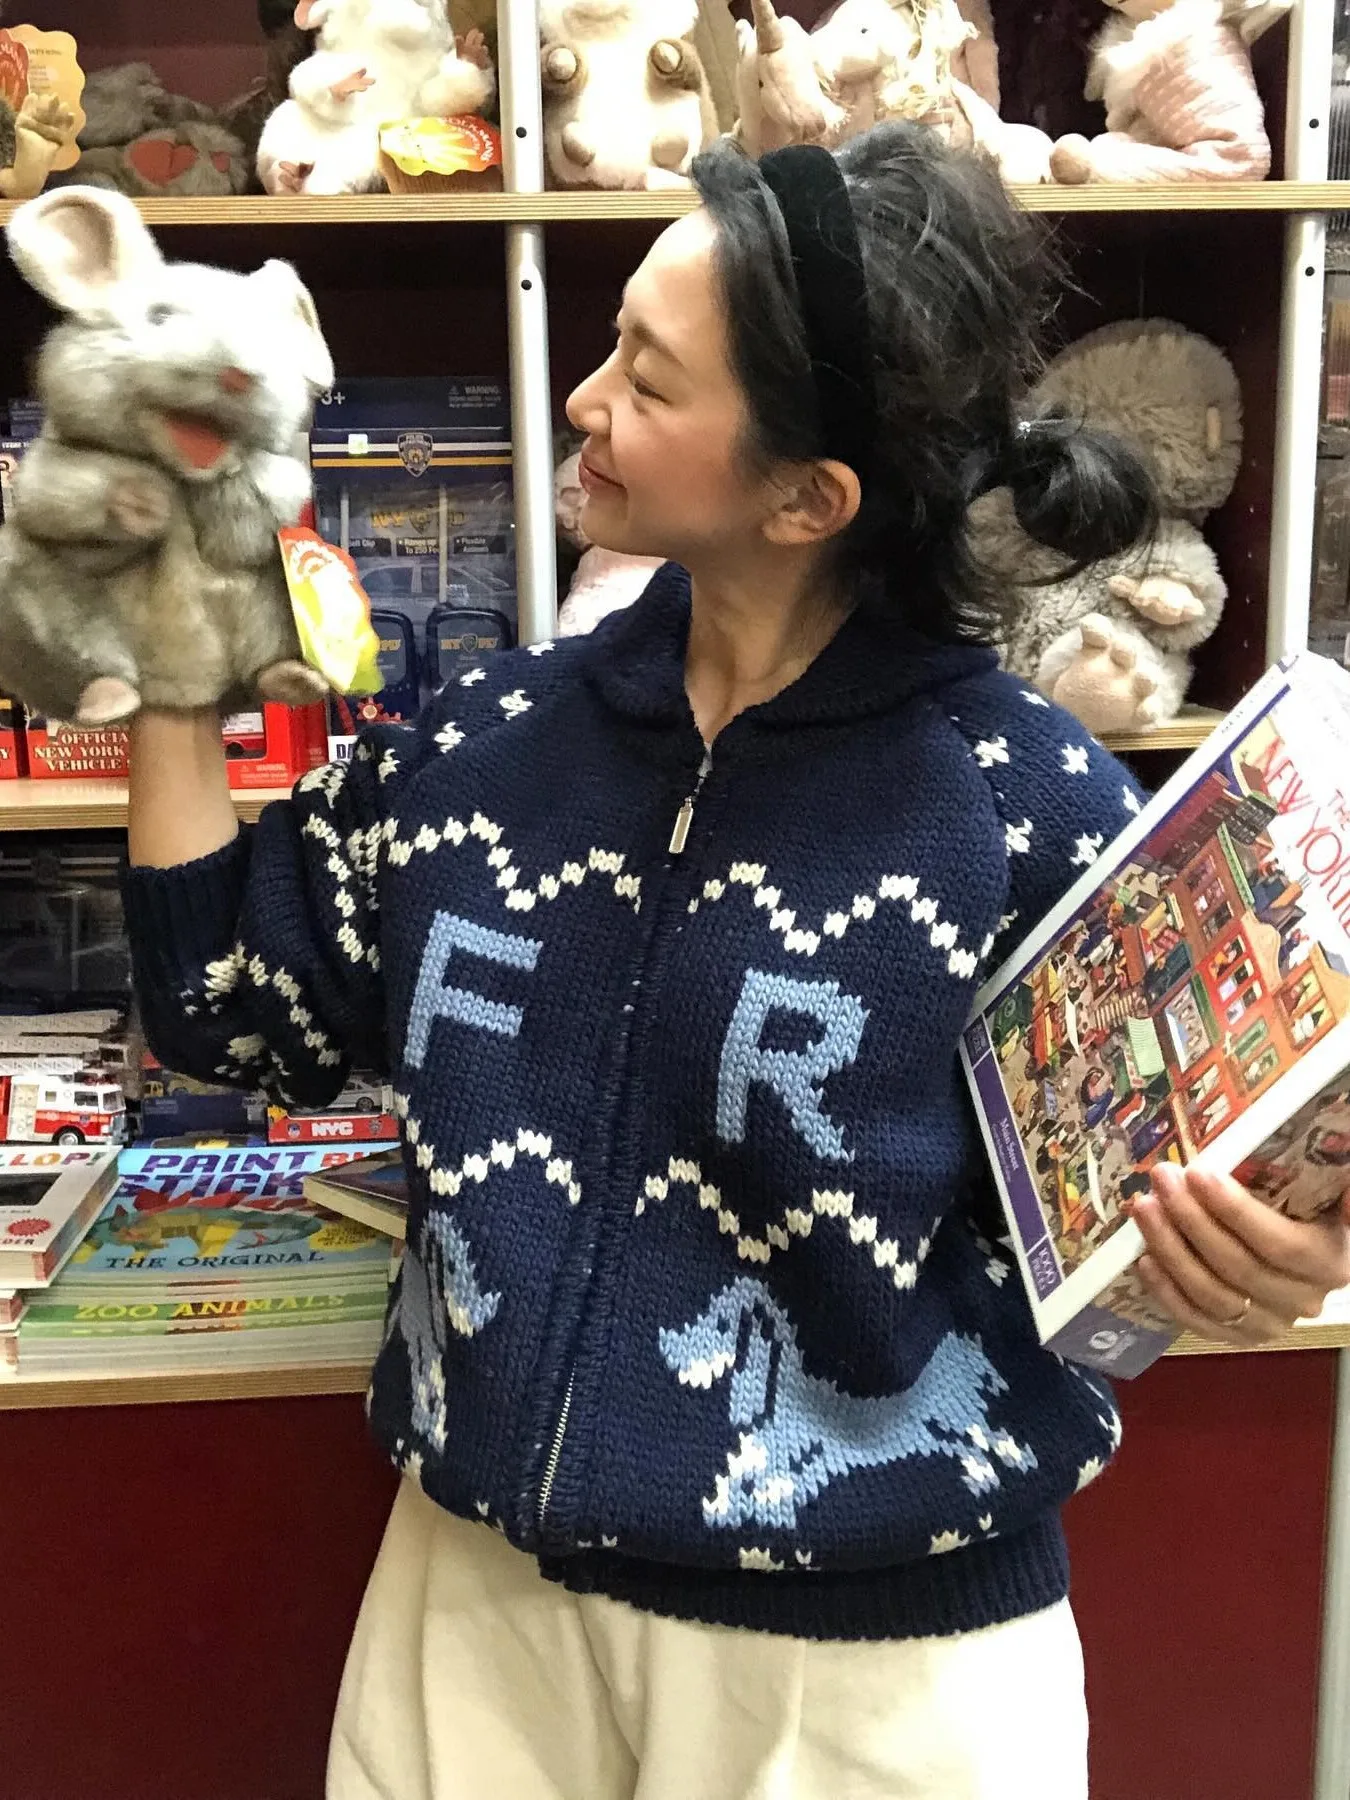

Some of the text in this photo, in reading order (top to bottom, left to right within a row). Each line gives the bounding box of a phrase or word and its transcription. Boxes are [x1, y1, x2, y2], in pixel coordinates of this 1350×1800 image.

[321, 391, 345, 405] 3+
[61, 732, 128, 745] OFFICIA
[34, 745, 125, 759] NEW YORK
[46, 759, 121, 771] VEHICLE
[404, 909, 543, 1069] F
[717, 967, 870, 1163] R
[311, 1121, 354, 1137] NYC
[141, 1151, 316, 1173] PAINT
[105, 1250, 325, 1269] THE ORIGINAL
[74, 1294, 344, 1320] ZOO ANIMALS
